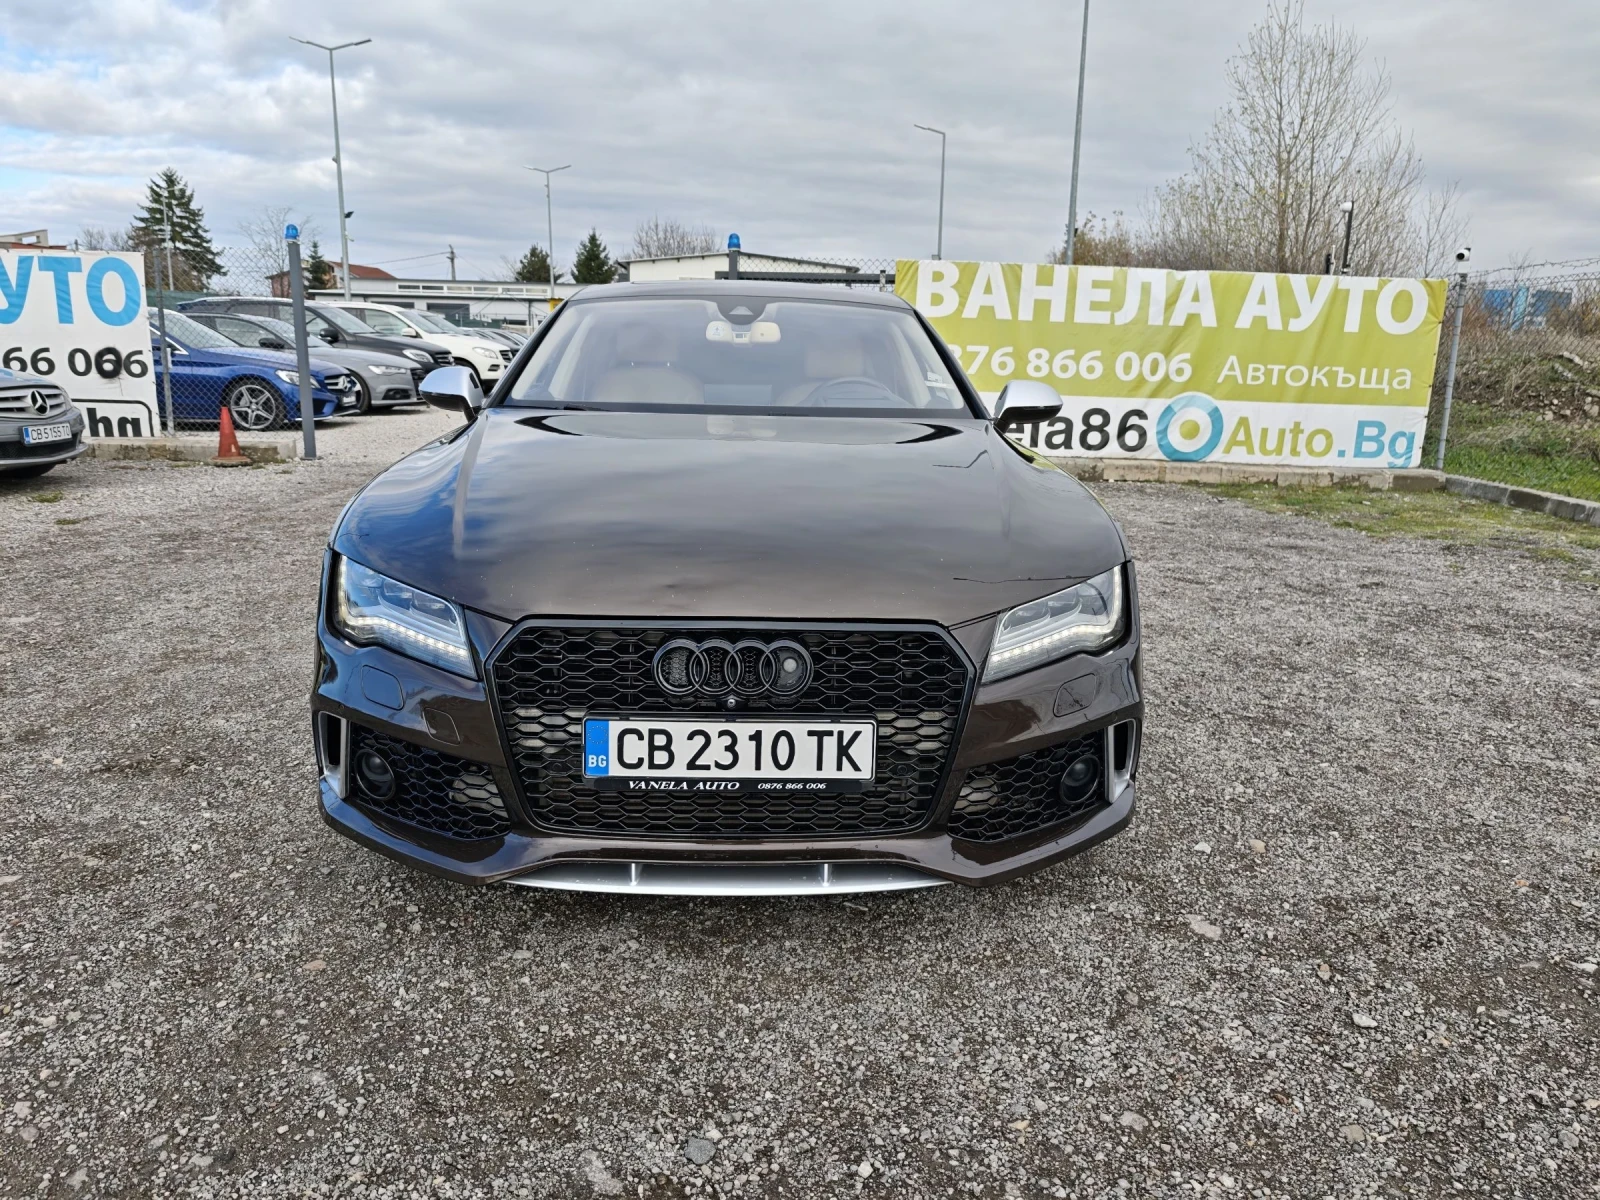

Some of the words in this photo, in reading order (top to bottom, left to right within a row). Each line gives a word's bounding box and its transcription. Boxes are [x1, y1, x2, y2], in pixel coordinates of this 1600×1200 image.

[915, 259, 1218, 327] ВАНЕЛА
[1233, 271, 1429, 336] АУТО
[1026, 347, 1104, 381] 866
[1114, 351, 1193, 384] 006
[1216, 355, 1412, 395] Автокъща
[1221, 416, 1416, 469] Auto.Bg
[588, 754, 607, 768] BG
[616, 727, 675, 770] CB
[686, 729, 796, 772] 2310
[806, 730, 863, 772] TK
[628, 780, 688, 791] VANELA
[693, 780, 741, 791] AUTO
[757, 782, 783, 790] 0876
[785, 782, 804, 790] 866
[806, 782, 827, 790] 006
